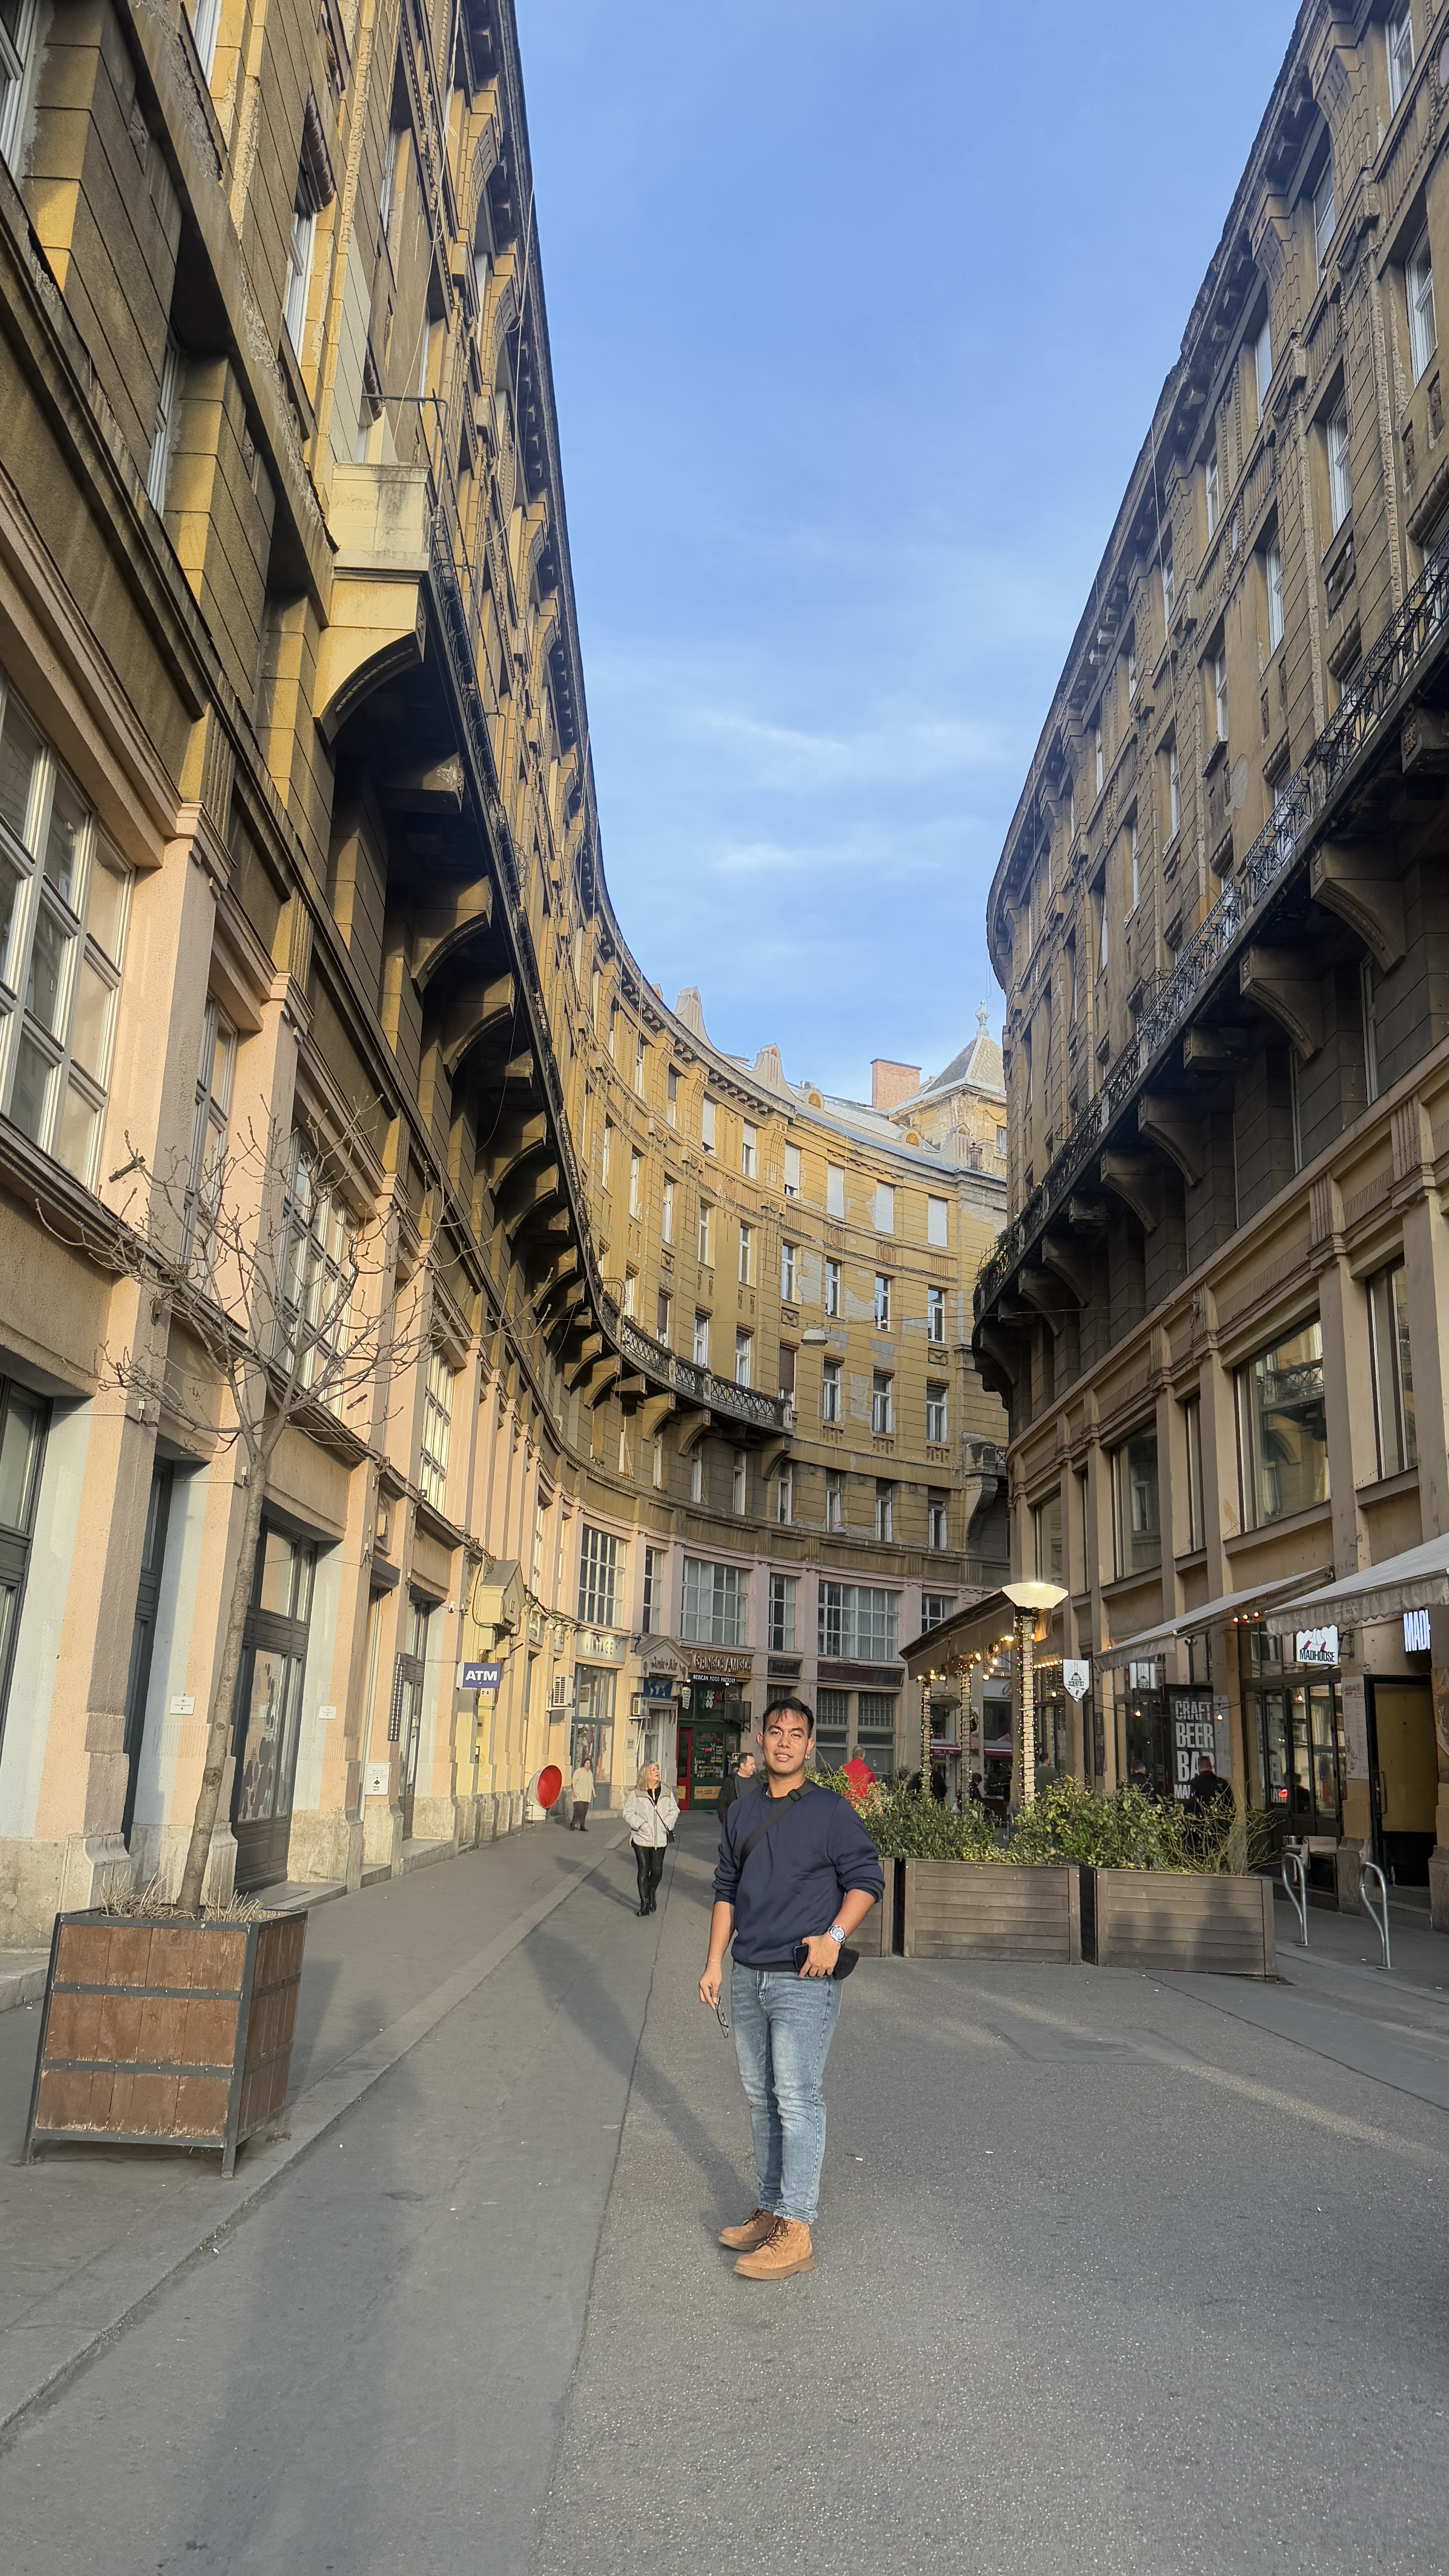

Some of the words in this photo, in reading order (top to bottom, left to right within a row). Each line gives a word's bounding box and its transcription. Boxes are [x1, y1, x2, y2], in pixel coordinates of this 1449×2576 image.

[694, 1653, 724, 1670] GRINGOS
[725, 1657, 751, 1672] AMIGOS
[1299, 1649, 1335, 1662] MADHOUSE
[465, 1670, 497, 1681] ATM
[1175, 1701, 1212, 1720] CRAFT
[1176, 1722, 1214, 1748] BEER
